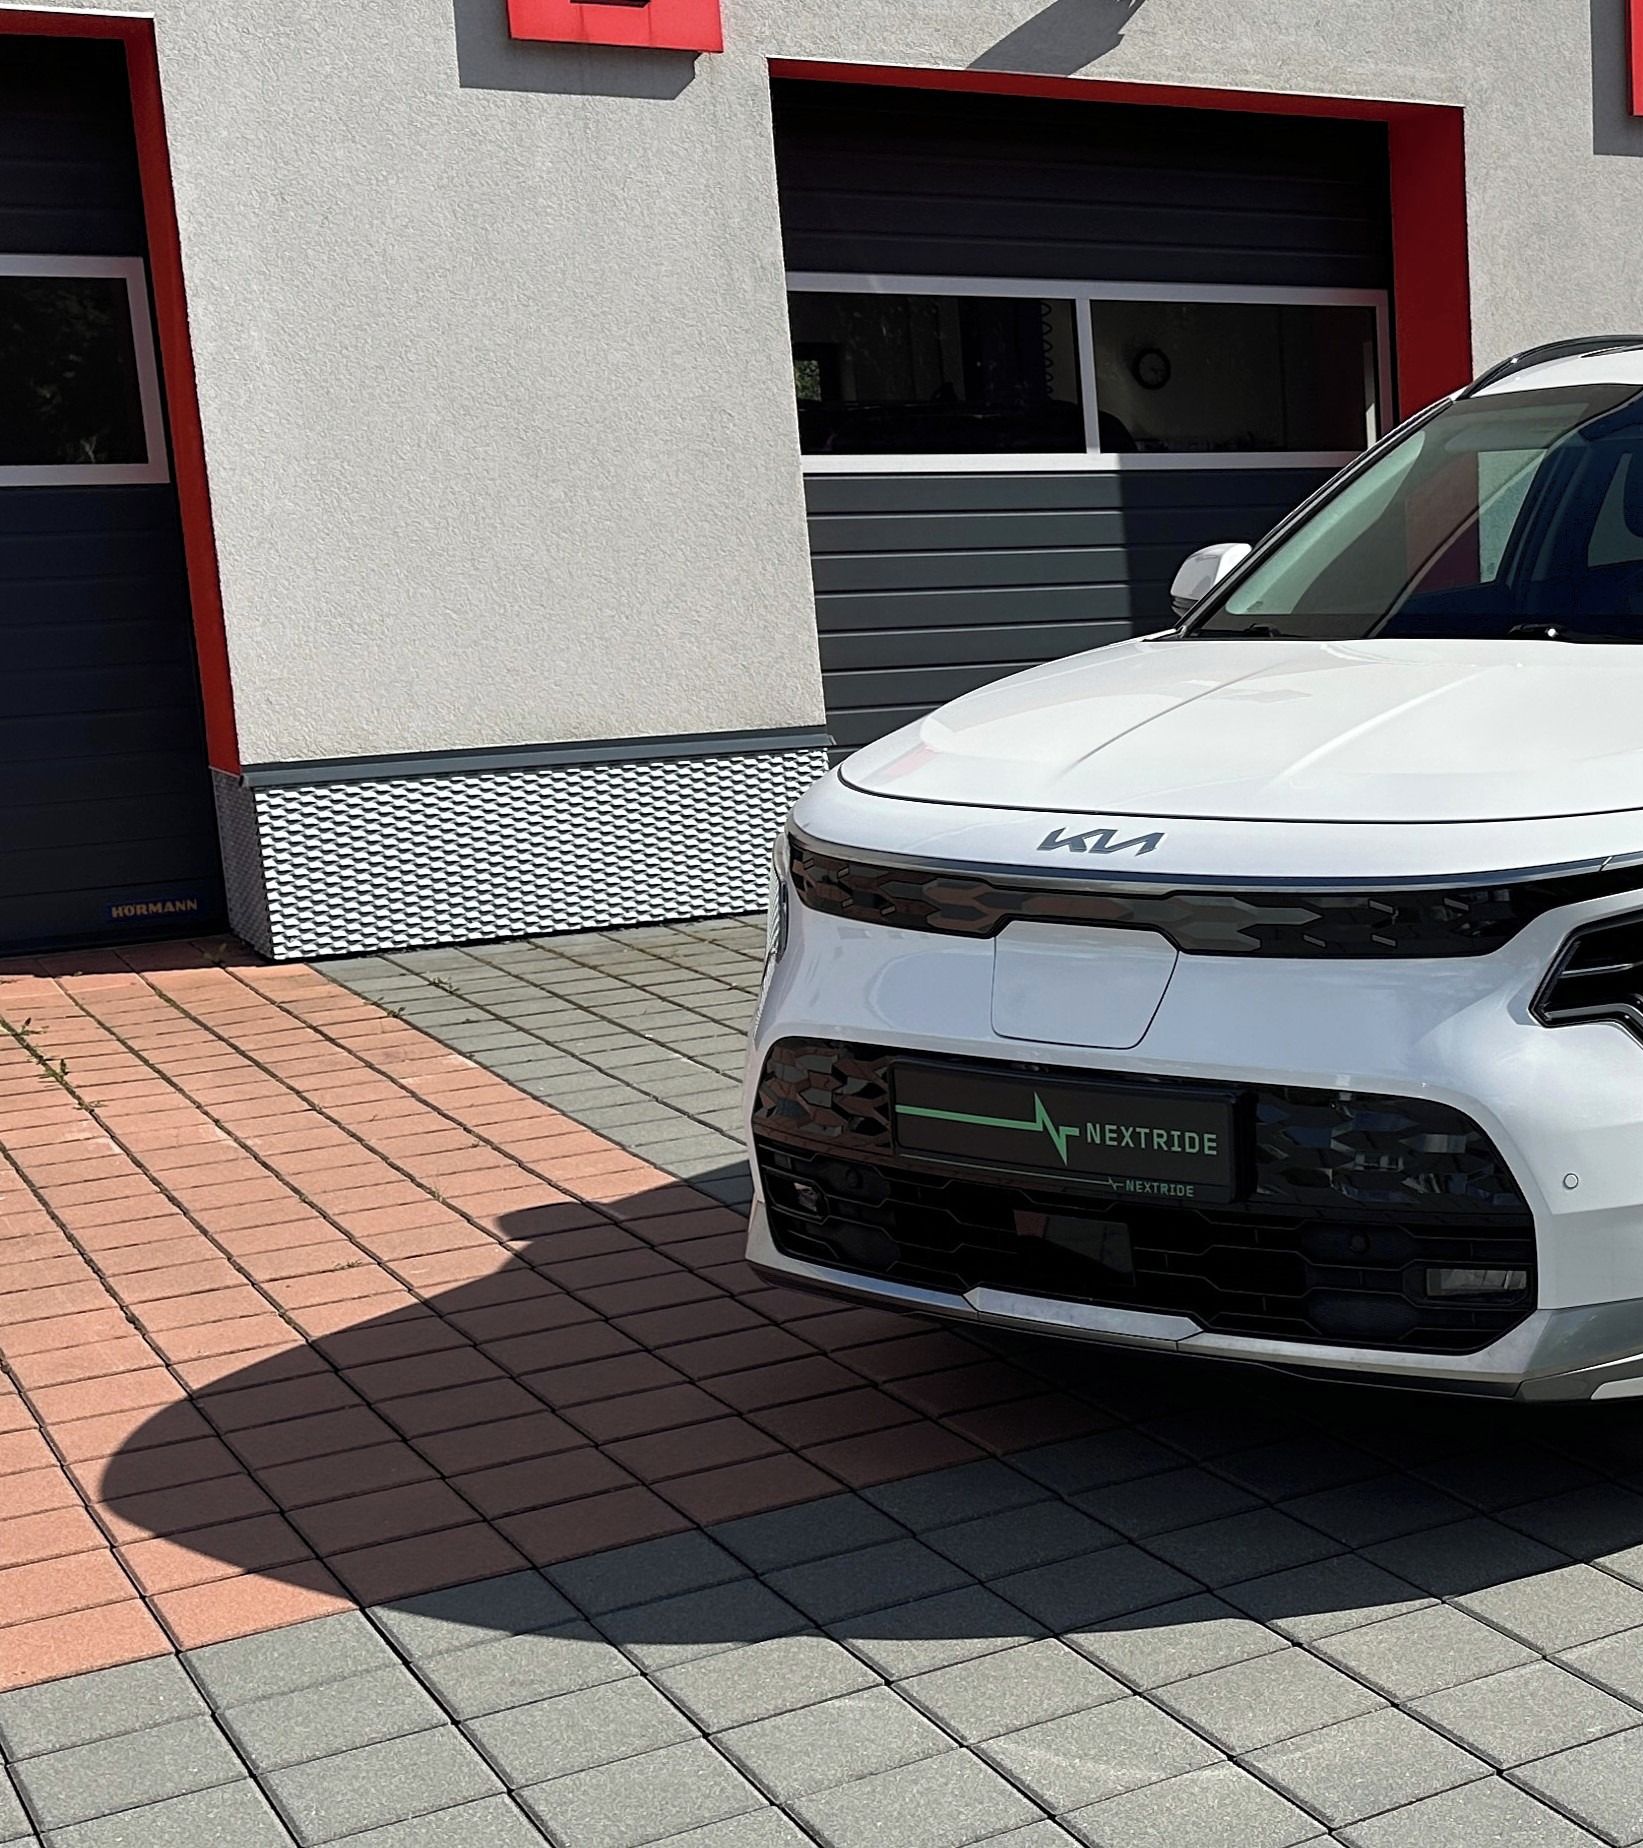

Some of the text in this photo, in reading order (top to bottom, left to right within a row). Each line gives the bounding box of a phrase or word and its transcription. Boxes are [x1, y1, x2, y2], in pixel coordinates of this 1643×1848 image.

[1036, 827, 1165, 856] KIA
[1086, 1122, 1217, 1155] NEXTRIDE
[1125, 1179, 1194, 1197] NEXTRIDE
